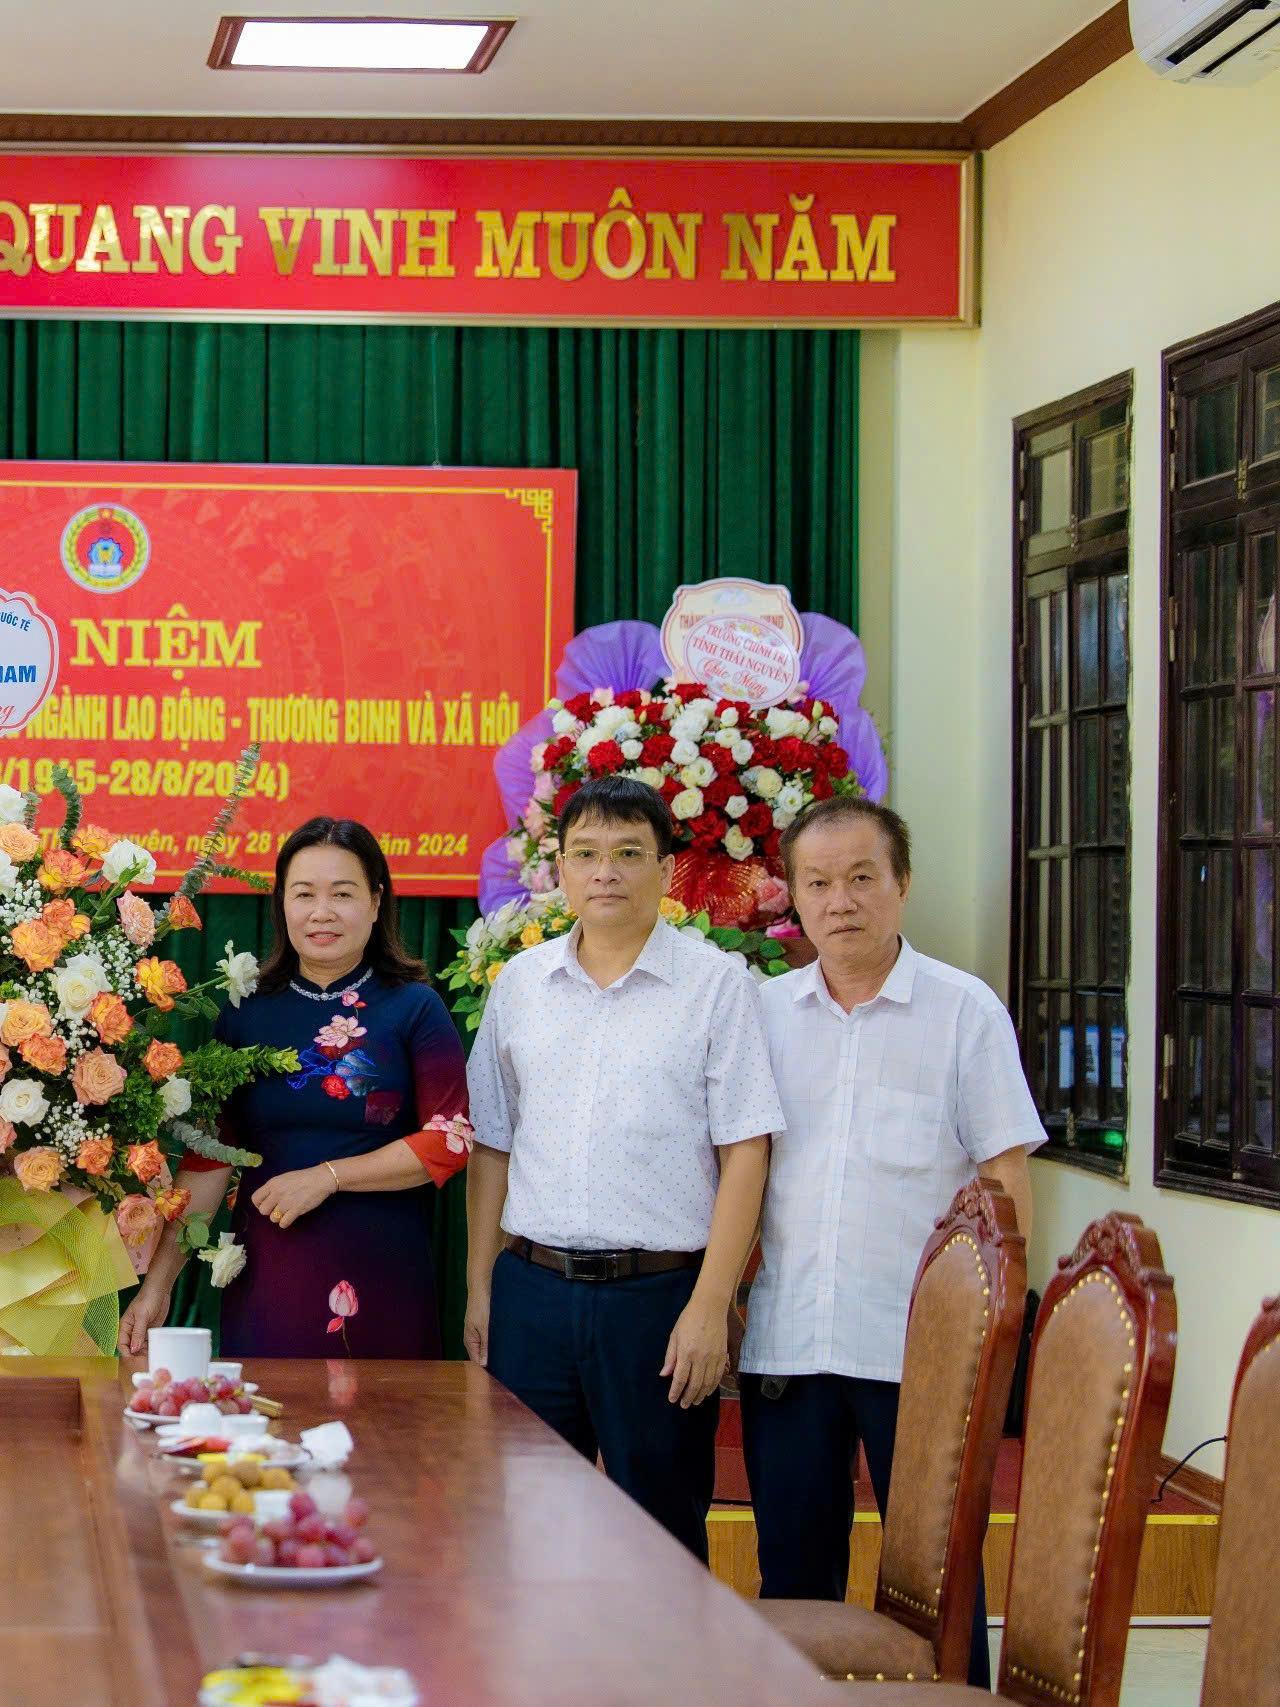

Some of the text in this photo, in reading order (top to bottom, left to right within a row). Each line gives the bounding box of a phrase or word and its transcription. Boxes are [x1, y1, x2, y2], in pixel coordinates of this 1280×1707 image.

[259, 206, 455, 278] VINH
[475, 187, 703, 280] MUÔN
[720, 194, 896, 282] NĂM
[19, 618, 32, 632] TẾ
[70, 603, 262, 680] NIỆM
[113, 695, 156, 741] LAO
[161, 686, 226, 751] ĐỘNG
[247, 693, 339, 744] THƯƠNG
[344, 699, 400, 744] BINH
[406, 690, 436, 745] VÀ
[442, 690, 475, 745] XÃ
[245, 832, 270, 851] 28
[417, 833, 469, 856] 2024
